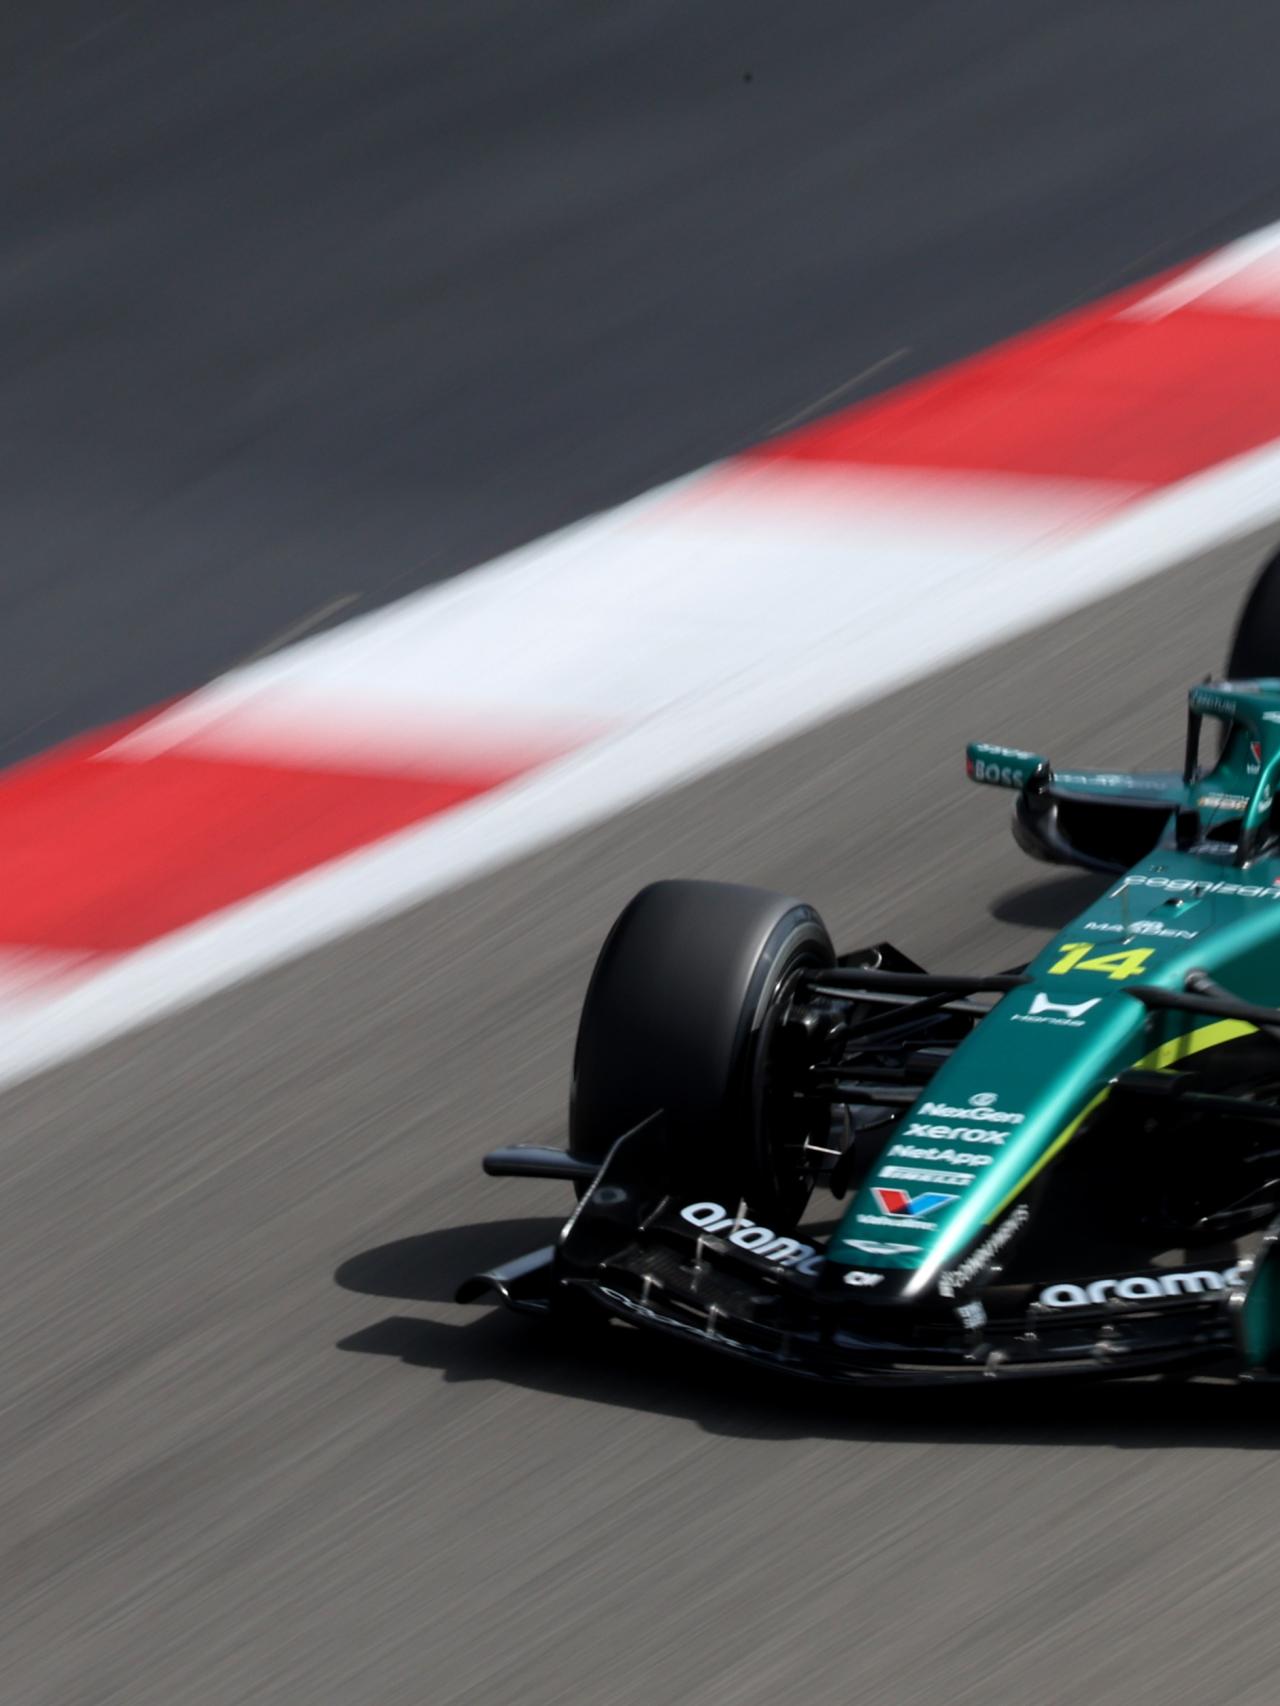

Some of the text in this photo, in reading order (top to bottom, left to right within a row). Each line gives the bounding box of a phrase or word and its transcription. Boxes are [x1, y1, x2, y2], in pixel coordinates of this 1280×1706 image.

[974, 761, 1023, 787] BOSS
[1047, 942, 1156, 980] 14
[916, 1102, 1025, 1124] NexGen
[902, 1122, 1011, 1145] xerox
[886, 1144, 993, 1166] NetApp
